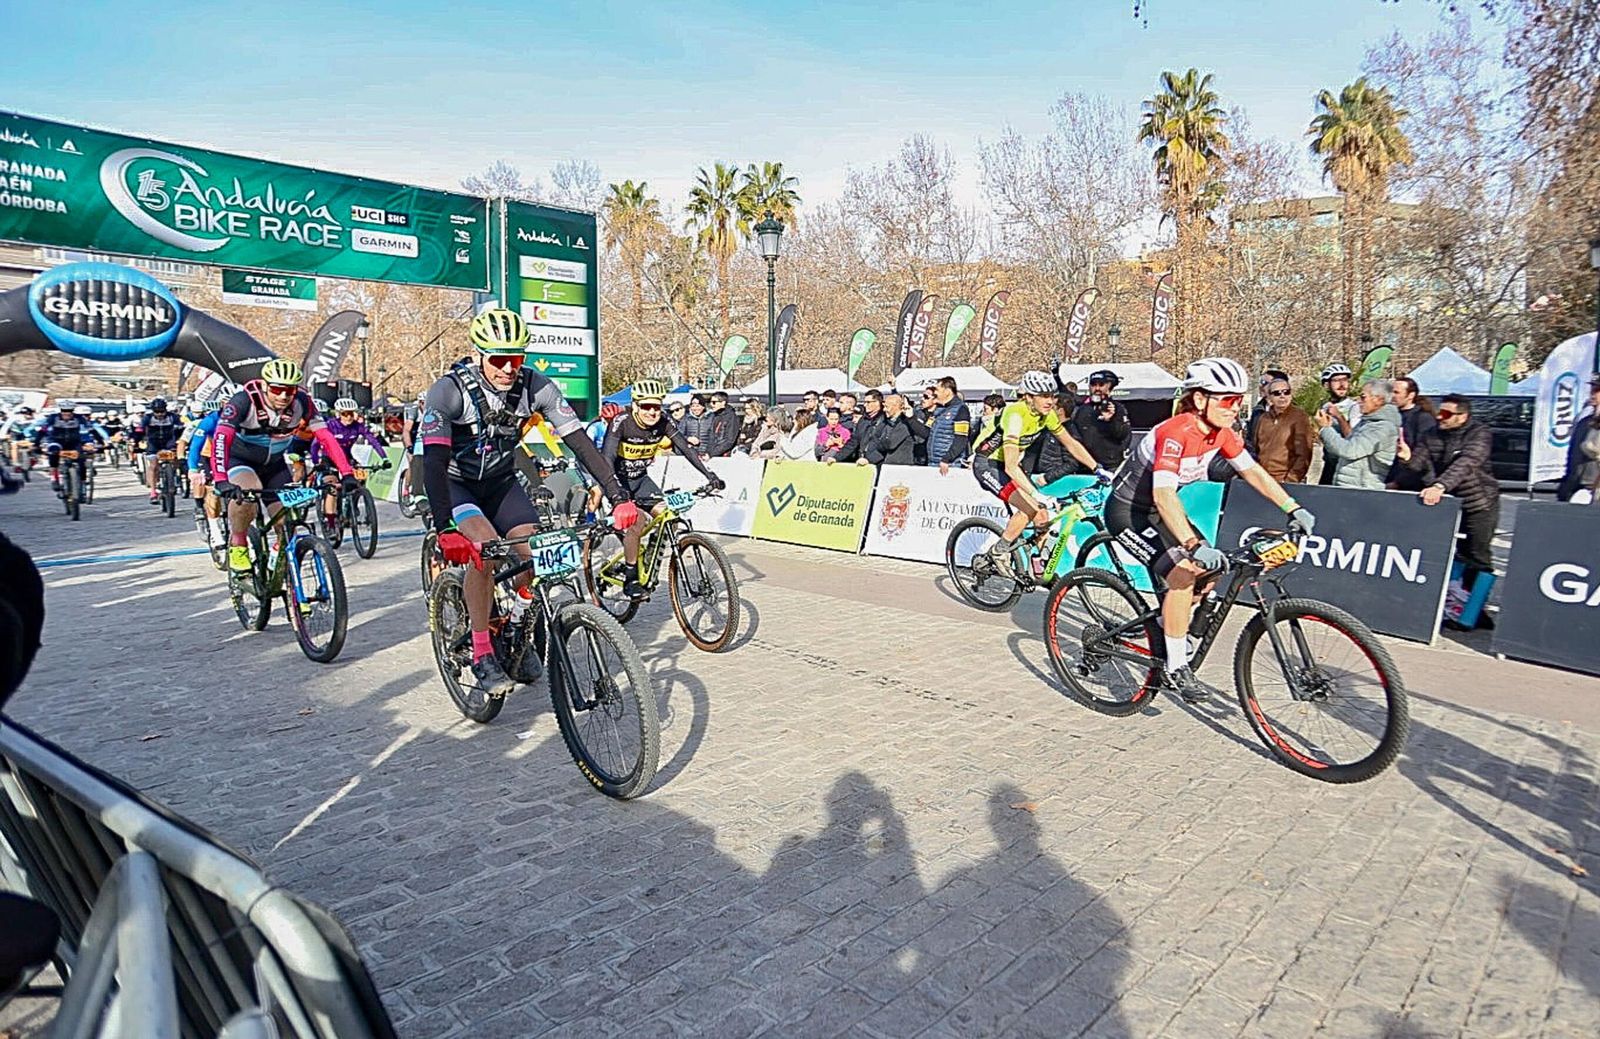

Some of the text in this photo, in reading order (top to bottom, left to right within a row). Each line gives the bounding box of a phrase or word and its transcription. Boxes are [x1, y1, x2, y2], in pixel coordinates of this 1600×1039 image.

[173, 167, 340, 225] Andalucía
[357, 208, 382, 222] UCI
[174, 203, 342, 248] BIKE RACE
[359, 236, 412, 251] GARMIN
[245, 275, 286, 286] STAGE
[251, 286, 291, 297] GRANADA
[529, 333, 583, 347] GARMIN
[1551, 382, 1574, 440] CRUZ
[797, 495, 855, 512] Diputación
[917, 499, 1009, 518] AYUNTAMIENTO
[793, 510, 855, 528] de Granada
[921, 516, 936, 529] DE
[1239, 527, 1427, 584] RMIN.
